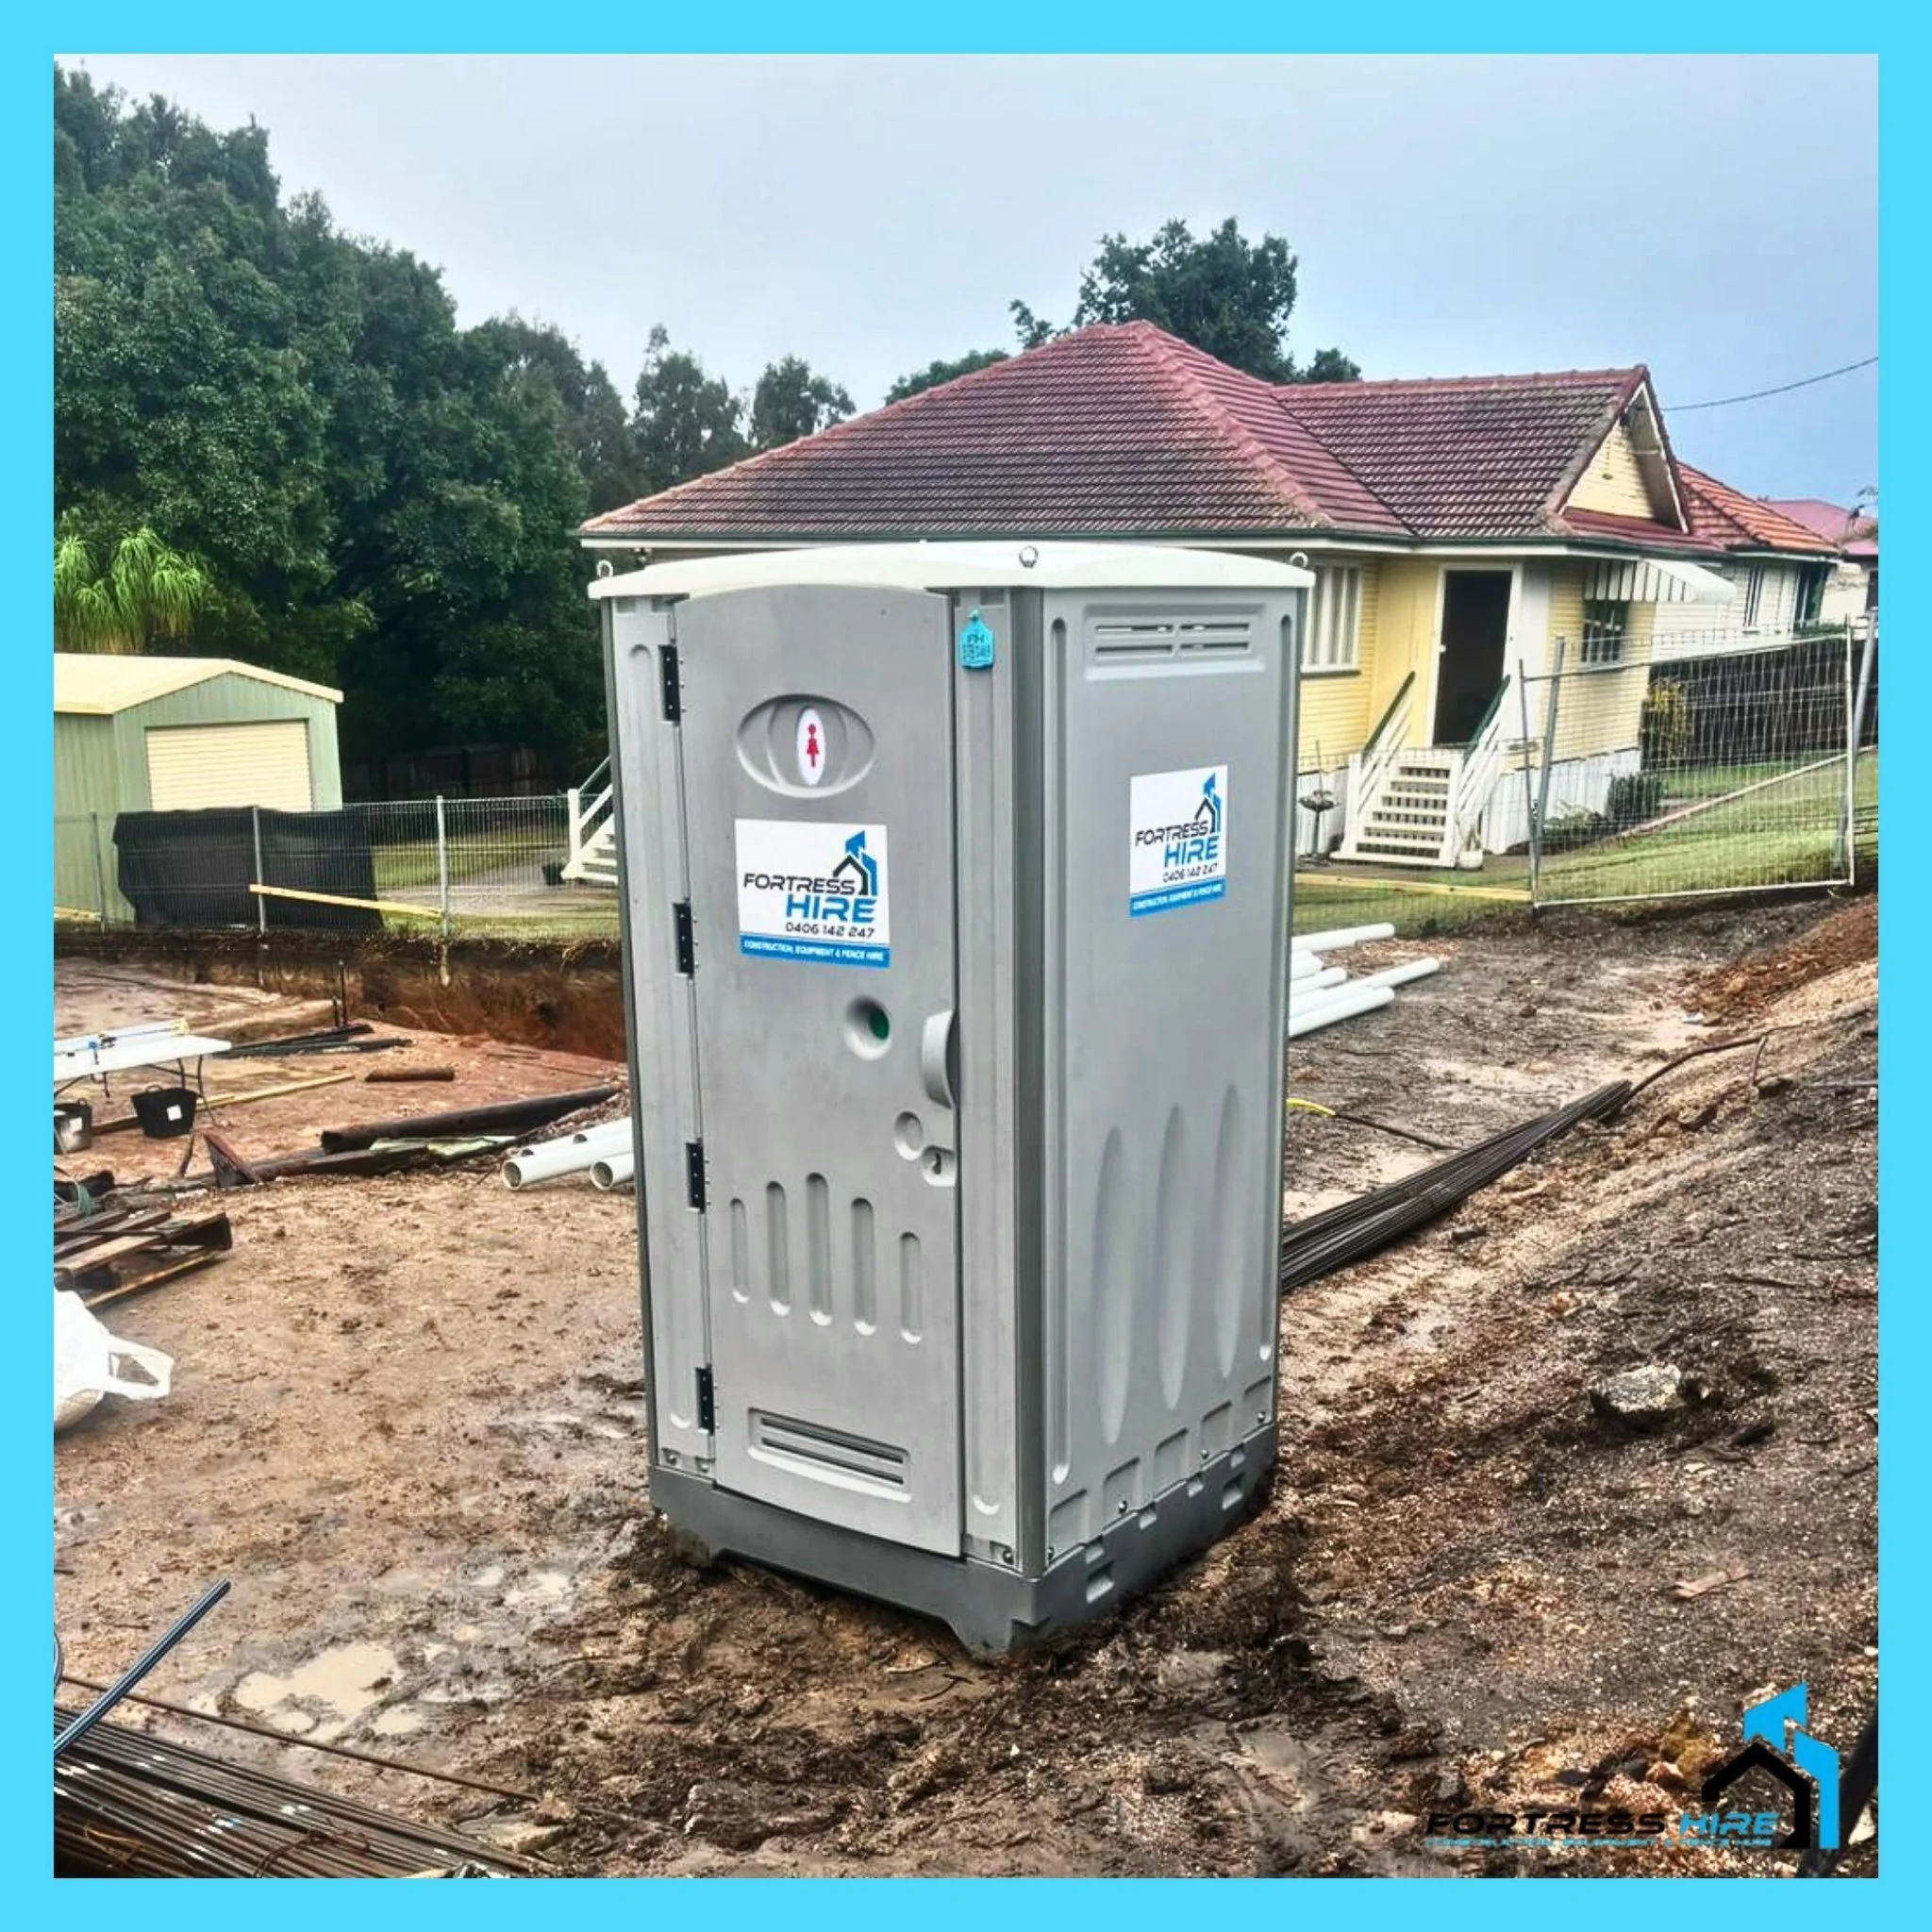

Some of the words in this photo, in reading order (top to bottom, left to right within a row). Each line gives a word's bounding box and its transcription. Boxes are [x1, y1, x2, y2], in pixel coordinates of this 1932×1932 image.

[1135, 820, 1208, 846] FORTRESS
[1163, 836, 1219, 868] HIRE
[743, 873, 855, 895] FORTRESS
[786, 893, 877, 924] HIRE
[785, 922, 819, 934] 0406
[823, 925, 844, 937] 142
[848, 927, 874, 938] 247
[795, 945, 834, 958] EQUIPMENT
[842, 949, 865, 960] FENCE
[866, 952, 885, 962] HIRE
